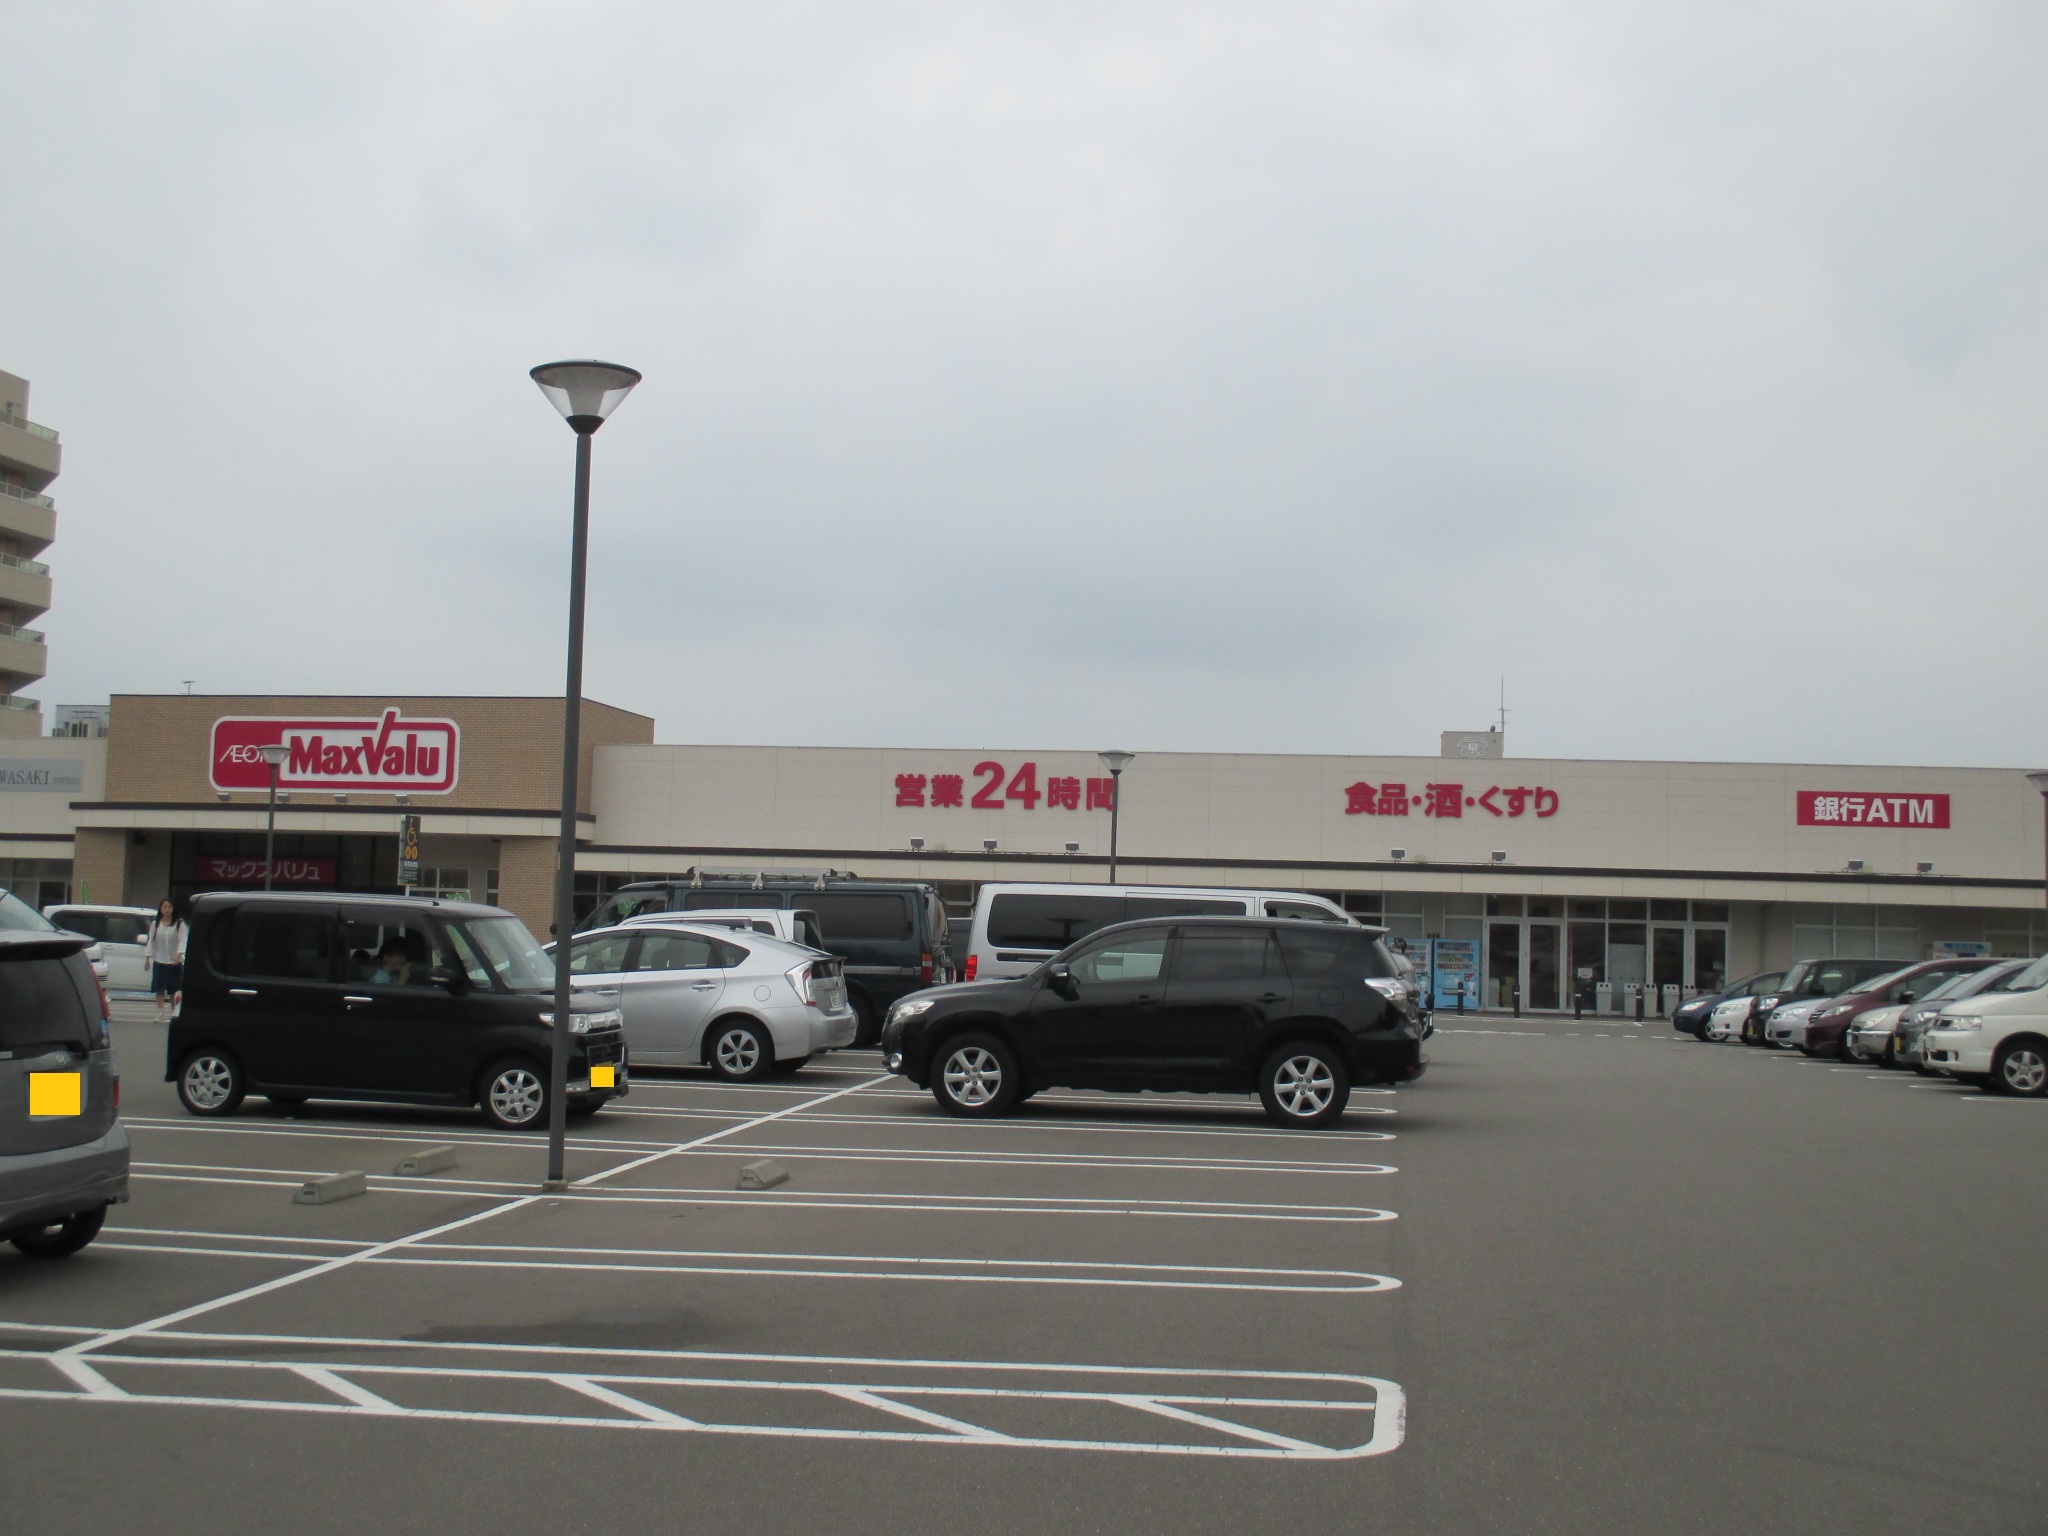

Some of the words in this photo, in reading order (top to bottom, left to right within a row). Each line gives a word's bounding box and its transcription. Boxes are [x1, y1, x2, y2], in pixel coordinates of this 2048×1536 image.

[289, 711, 440, 776] MaxValu
[895, 761, 1114, 811] 営業24時間
[1345, 782, 1559, 818] 食品・酒・くすり
[1814, 796, 1933, 823] 銀行ATM
[211, 860, 320, 880] マックスバリュ
